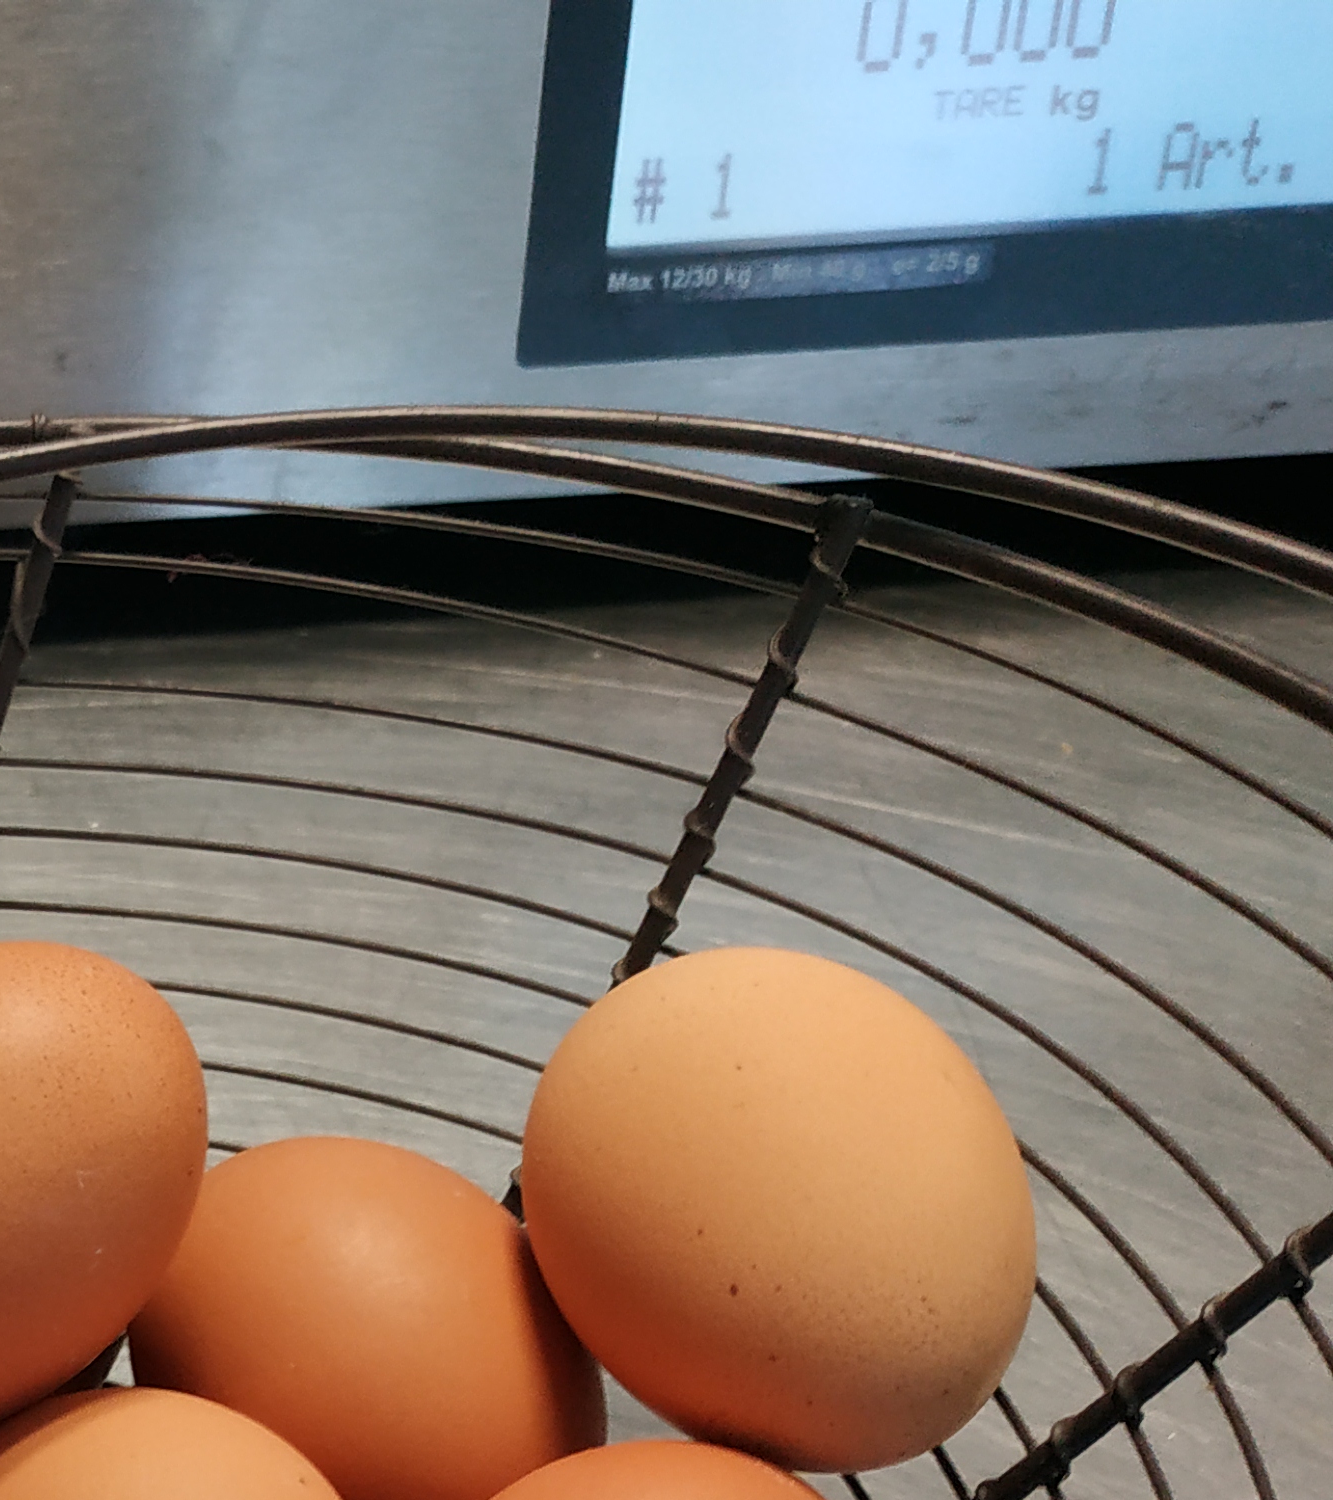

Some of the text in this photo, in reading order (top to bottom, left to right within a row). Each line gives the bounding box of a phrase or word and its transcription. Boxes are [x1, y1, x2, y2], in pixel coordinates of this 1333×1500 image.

[934, 84, 1100, 121] TARE kg
[1087, 117, 1296, 195] 1 Art.
[633, 152, 733, 224] # 1
[607, 271, 654, 293] Max
[660, 264, 718, 291] 12/30
[724, 262, 752, 290] kg
